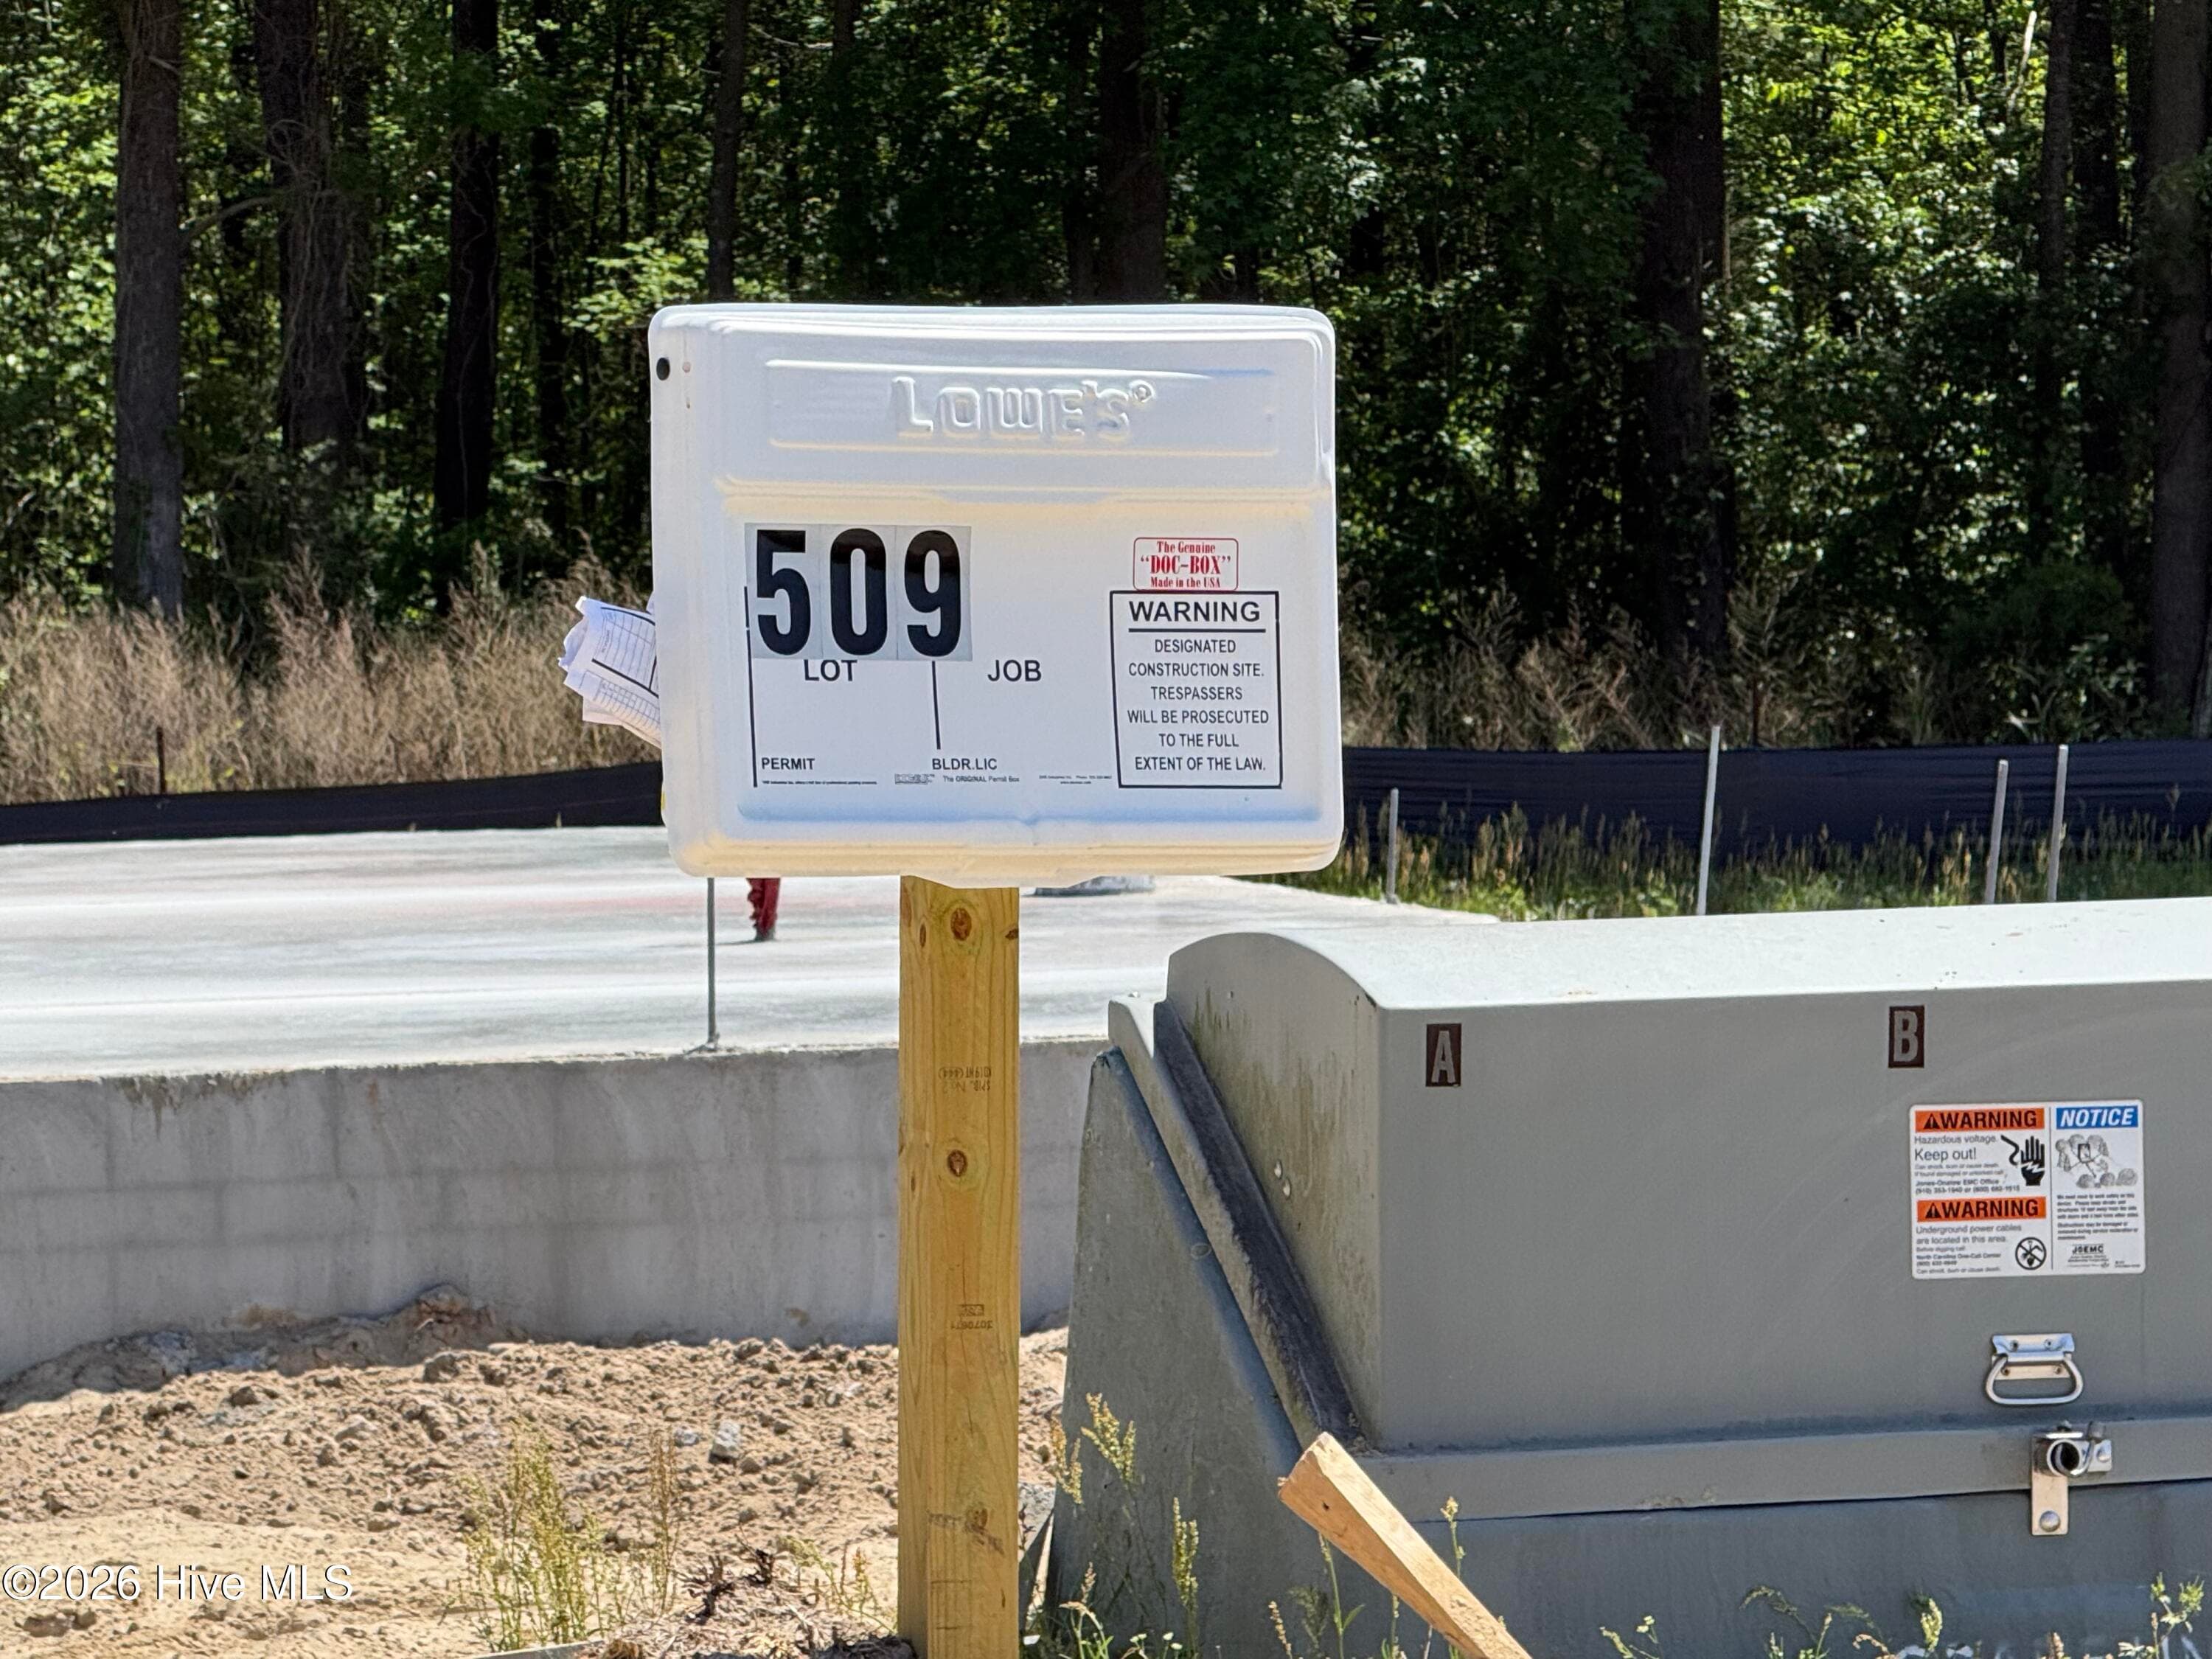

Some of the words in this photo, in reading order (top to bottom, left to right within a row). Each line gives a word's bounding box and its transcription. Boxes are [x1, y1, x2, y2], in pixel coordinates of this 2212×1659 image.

[1157, 541, 1176, 553] The
[1178, 541, 1216, 553] Genuine
[1150, 577, 1173, 588] Made
[1175, 577, 1183, 588] in
[1186, 577, 1201, 588] the
[1203, 577, 1221, 588] USA
[757, 527, 961, 657] 509
[1129, 601, 1261, 622] WARNING
[1155, 639, 1237, 653] DESIGNATED
[803, 659, 858, 682] LOT
[987, 658, 1042, 682] JOB
[1128, 662, 1228, 677] CONSTRUCTION
[1232, 663, 1265, 677] SITE.
[1151, 686, 1243, 700] TRESPASSERS
[1127, 710, 1158, 723] WILL
[1161, 710, 1178, 723] BE
[1182, 710, 1269, 724] PROSECUTED
[1158, 734, 1175, 747] TO
[1179, 734, 1204, 747] THE
[1208, 734, 1239, 747] FULL
[762, 757, 815, 770] PERMIT
[932, 758, 998, 771] BLDR.LIC
[1135, 757, 1183, 771] EXTENT
[1186, 757, 1203, 771] OF
[1207, 757, 1231, 771] THE
[1235, 757, 1266, 771] LAW.
[1893, 1010, 1919, 1063] B
[1430, 1030, 1457, 1085] A
[1940, 1110, 2037, 1129] WARNING
[2060, 1107, 2134, 1127] NOTICE
[1914, 1135, 1962, 1144] Hazardous
[1915, 1148, 1949, 1162] Keep
[1952, 1147, 1977, 1160] out!
[1941, 1199, 2038, 1218] WARNING
[1916, 1225, 1968, 1235] Underground
[1969, 1225, 1994, 1234] power
[1996, 1224, 2022, 1232] cables
